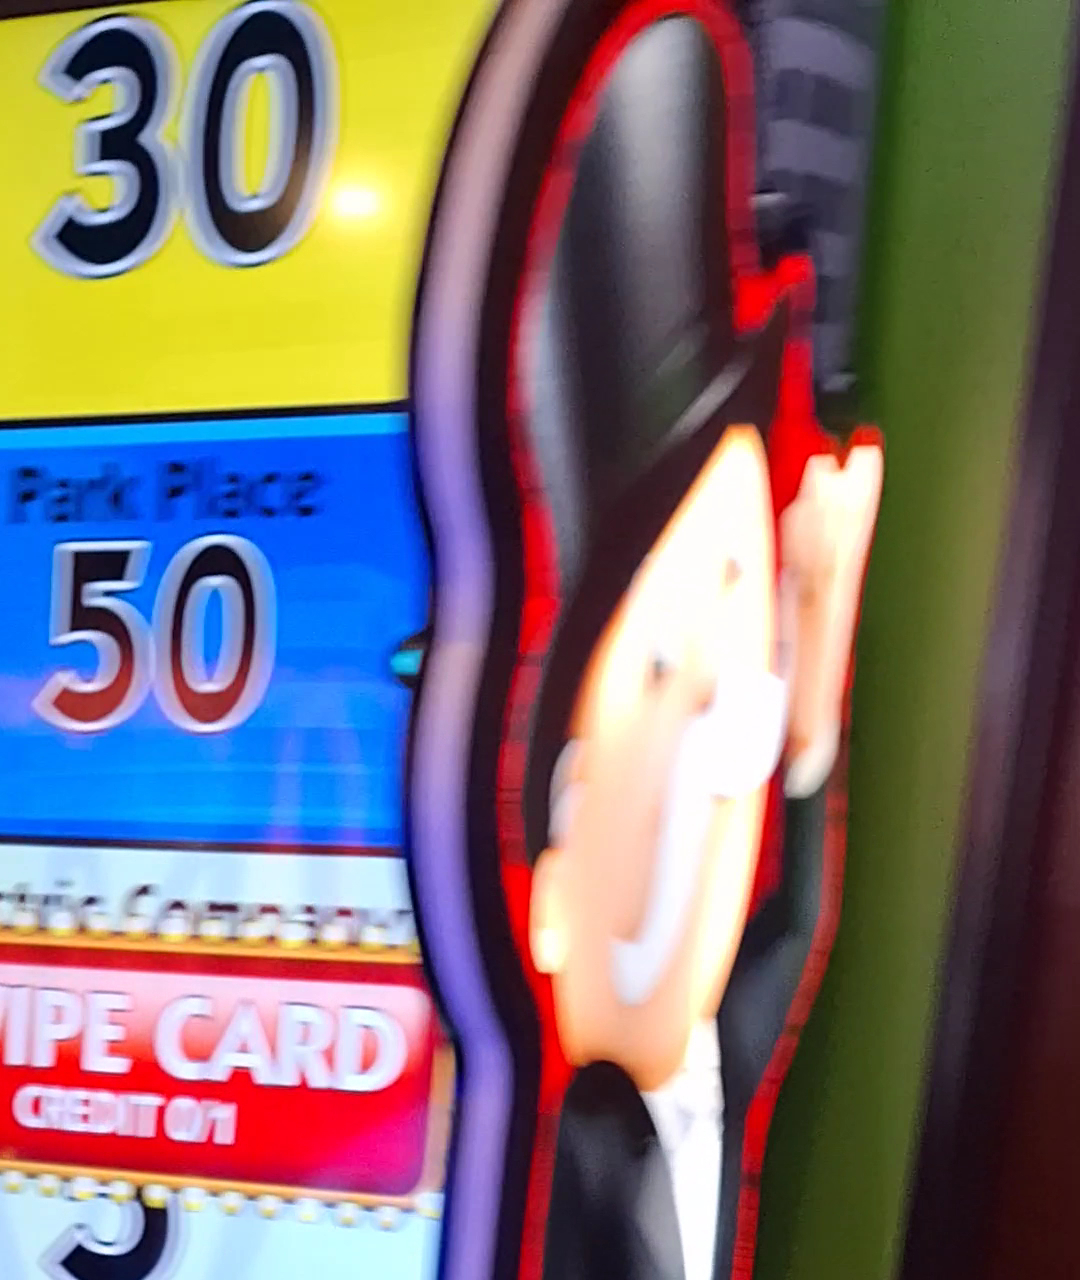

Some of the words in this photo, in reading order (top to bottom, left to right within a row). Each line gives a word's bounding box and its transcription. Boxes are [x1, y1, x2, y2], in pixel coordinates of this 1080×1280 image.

[30, 0, 341, 279] 30
[5, 467, 139, 525] Park
[156, 460, 322, 522] Place
[32, 532, 278, 735] 50
[153, 994, 410, 1093] CARD
[11, 1083, 167, 1139] CREDIT
